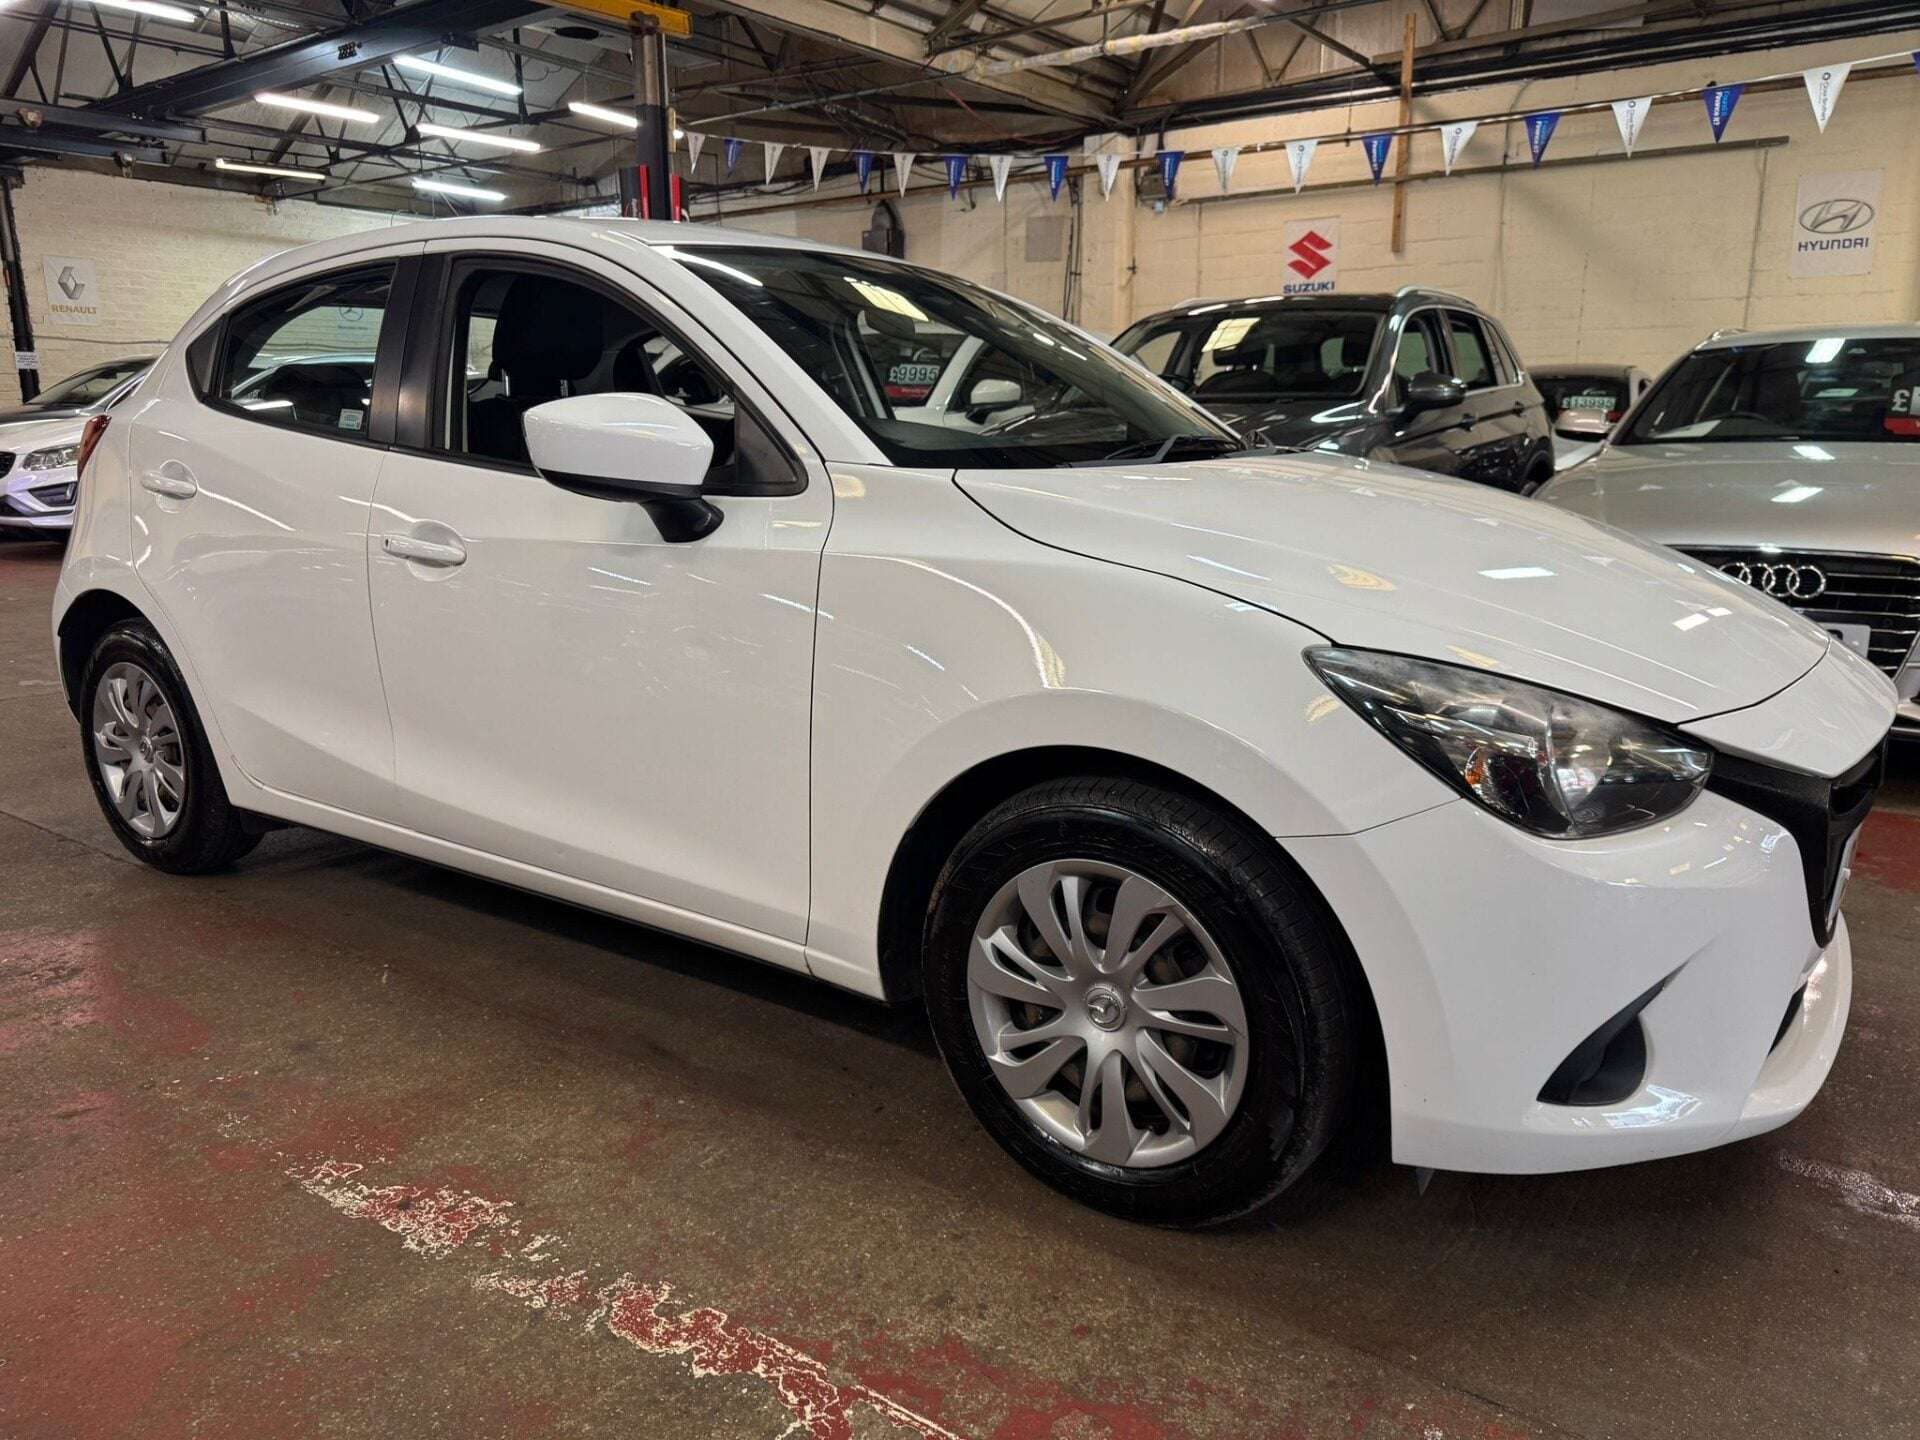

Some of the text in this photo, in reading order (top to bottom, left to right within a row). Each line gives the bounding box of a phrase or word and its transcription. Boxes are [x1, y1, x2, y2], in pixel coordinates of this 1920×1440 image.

[1798, 237, 1869, 252] HYUNDAI
[1283, 281, 1335, 295] SUZUKI
[51, 304, 97, 314] RENAULT
[889, 366, 938, 382] £9995
